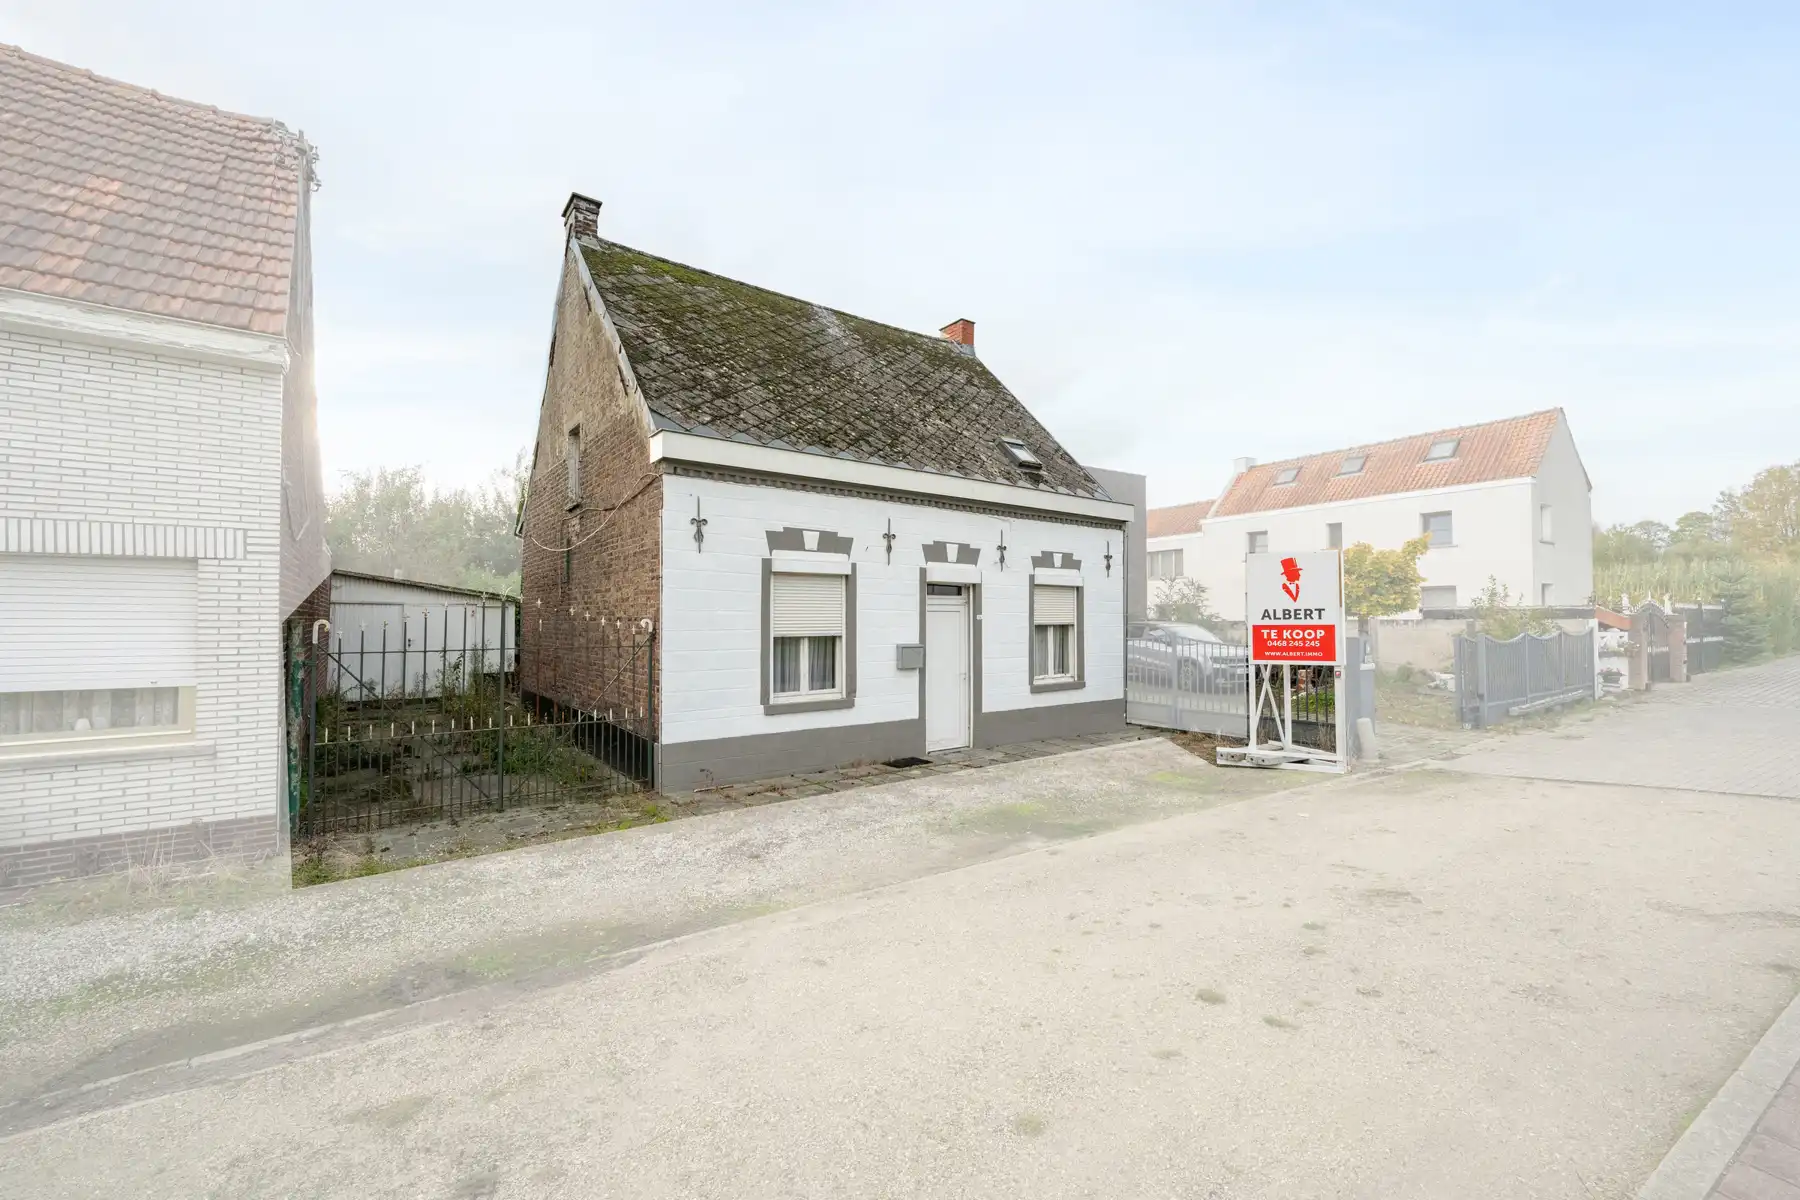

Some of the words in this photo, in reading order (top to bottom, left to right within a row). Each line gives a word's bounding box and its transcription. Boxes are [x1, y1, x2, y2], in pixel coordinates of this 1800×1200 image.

[1261, 608, 1325, 620] ALBERT
[1261, 629, 1278, 639] TE
[1283, 629, 1325, 639] KOOP
